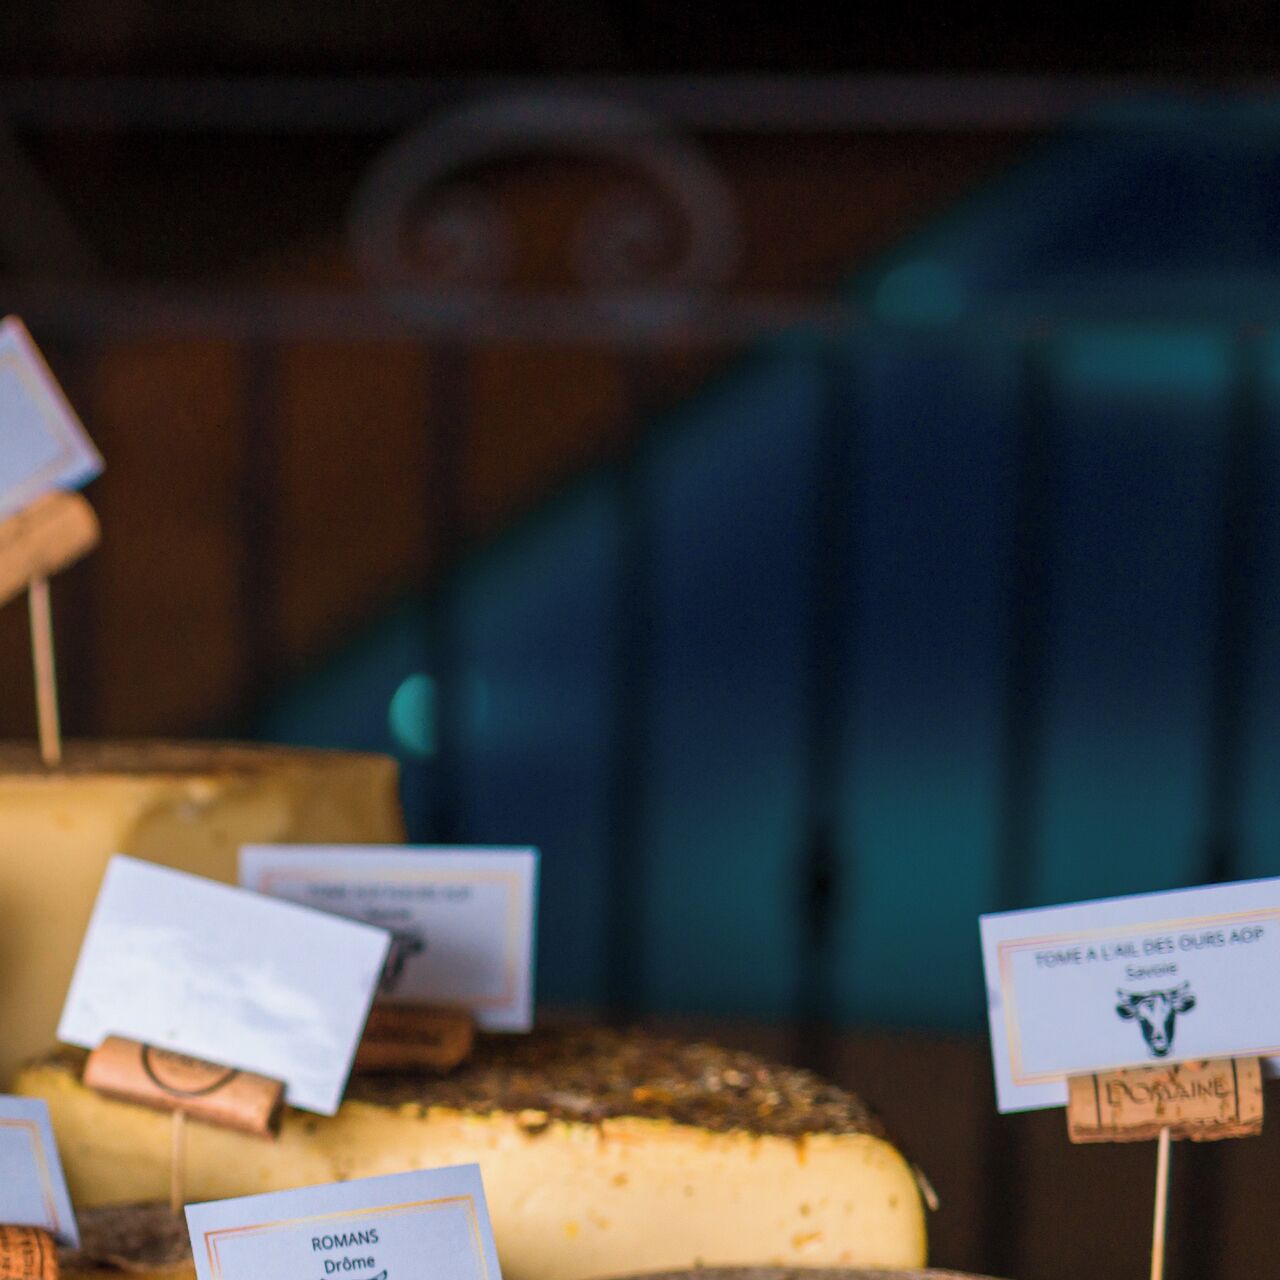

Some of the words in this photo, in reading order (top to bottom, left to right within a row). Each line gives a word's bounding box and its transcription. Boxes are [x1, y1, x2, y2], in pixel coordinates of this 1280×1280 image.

[1035, 947, 1082, 968] TOME
[1086, 946, 1098, 961] A
[1143, 938, 1174, 955] DES
[1178, 931, 1225, 951] OURS
[1229, 925, 1265, 944] AOP
[1125, 962, 1178, 980] Savoie
[311, 1228, 379, 1252] ROMANS
[324, 1255, 375, 1274] Drôme
